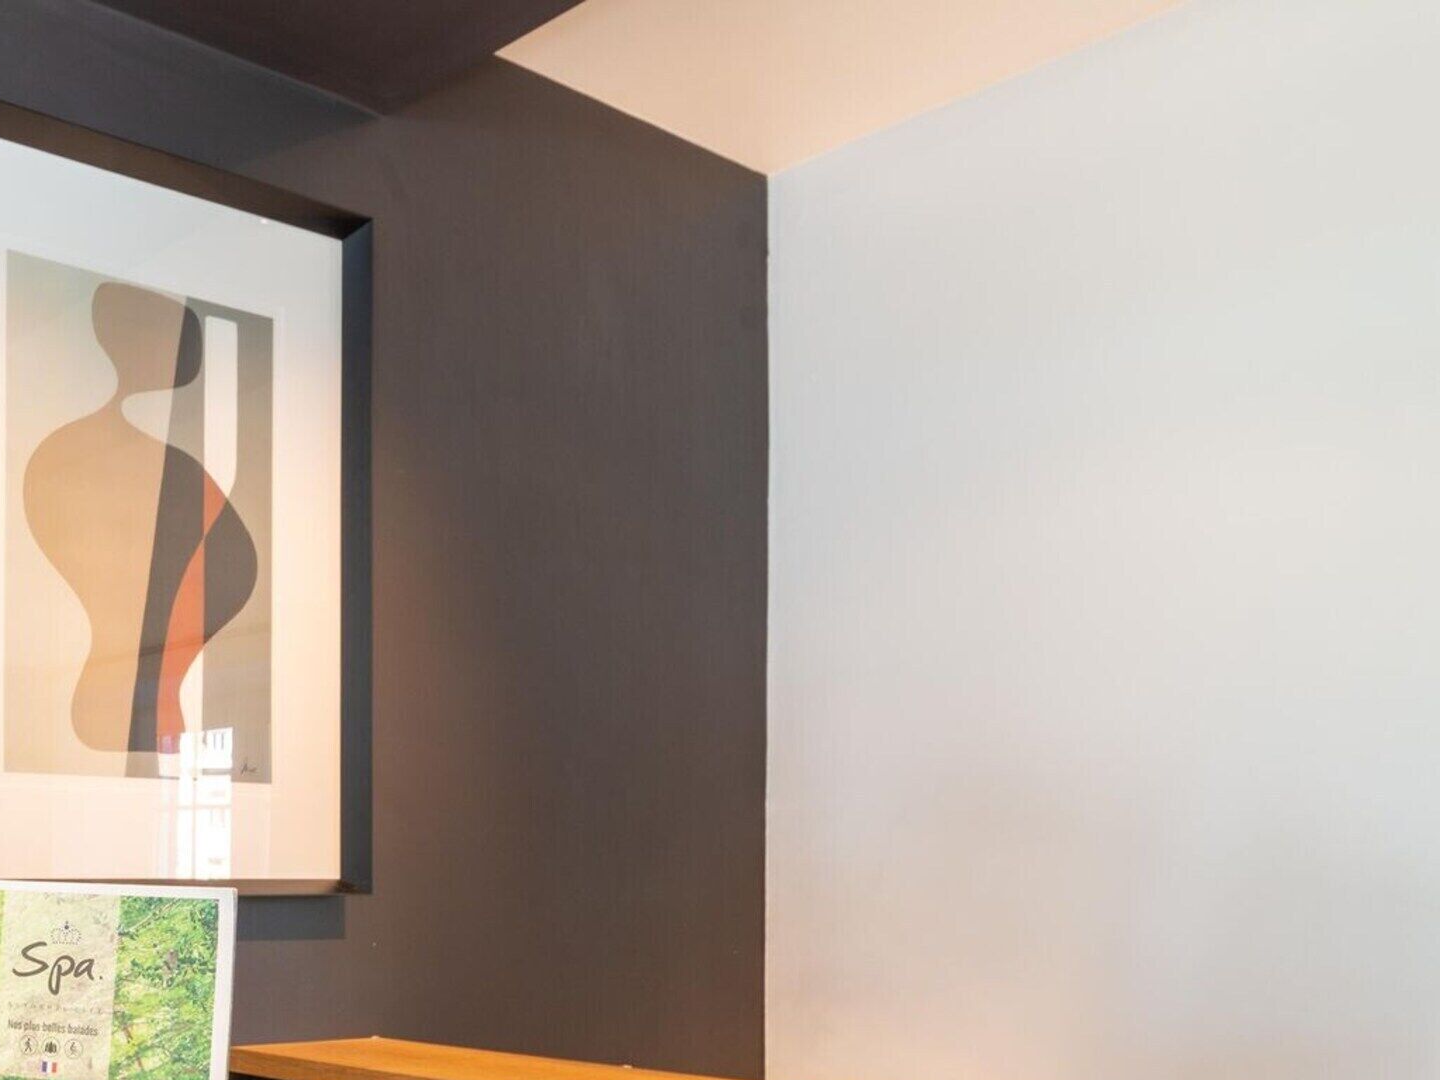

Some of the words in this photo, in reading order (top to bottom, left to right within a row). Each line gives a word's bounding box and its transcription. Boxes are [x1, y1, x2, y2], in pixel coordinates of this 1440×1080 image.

[23, 1020, 40, 1032] plus
[42, 1021, 66, 1034] belles
[67, 1023, 98, 1037] balades
